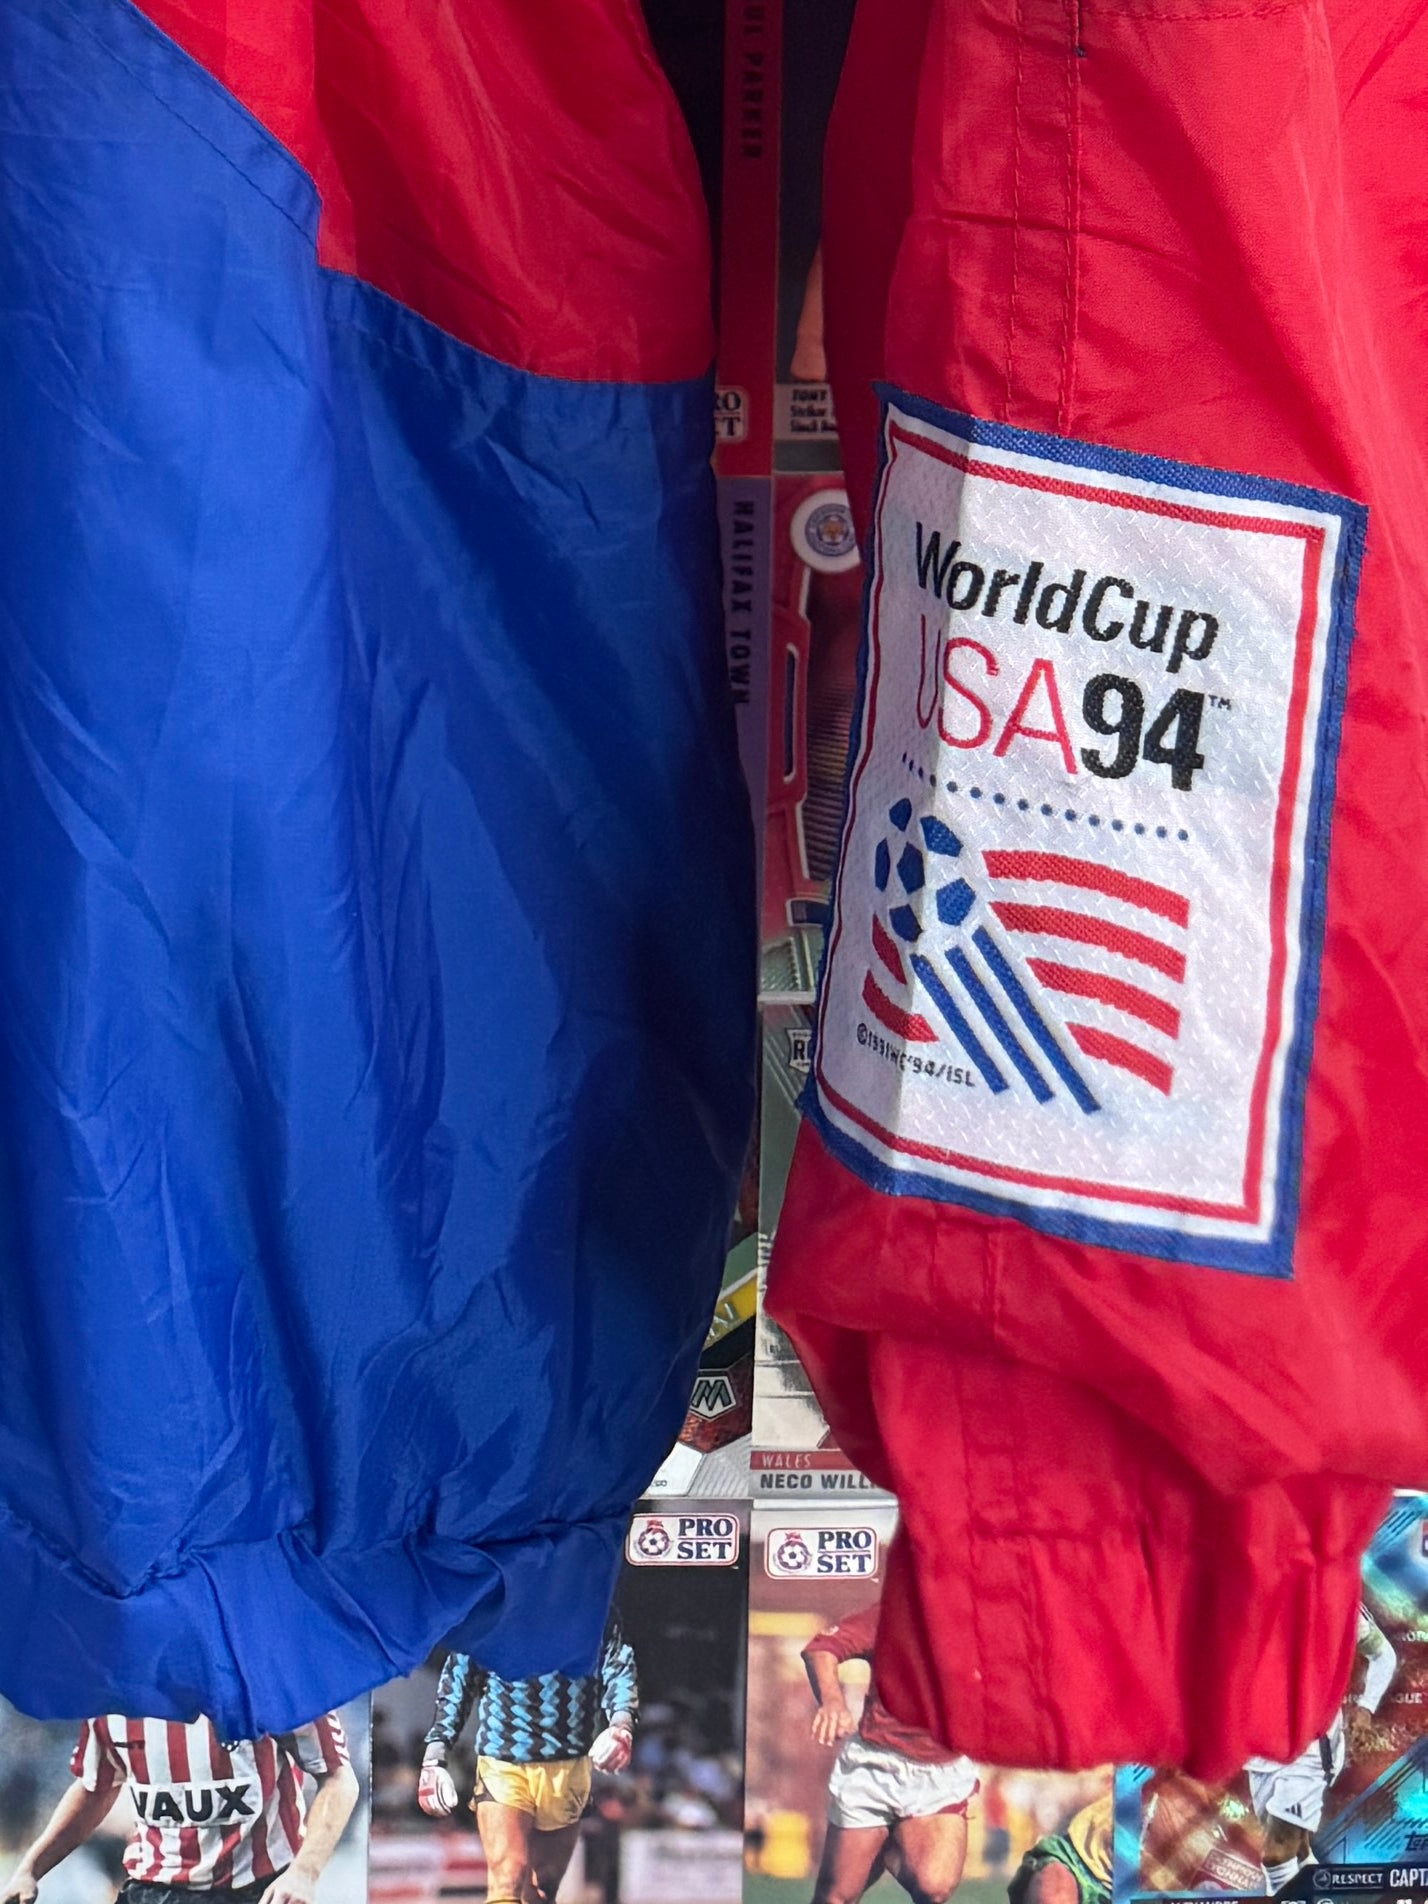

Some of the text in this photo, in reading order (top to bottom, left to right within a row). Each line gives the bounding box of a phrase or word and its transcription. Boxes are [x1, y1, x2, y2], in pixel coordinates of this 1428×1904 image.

[730, 501, 754, 612] HALIFAX
[916, 521, 1219, 674] WorldCup
[762, 1453, 811, 1468] WALES
[760, 1473, 812, 1490] NECO
[678, 1518, 733, 1537] PRO
[817, 1531, 871, 1550] PRO
[677, 1542, 732, 1560] SET
[817, 1554, 871, 1573] SET
[130, 1784, 256, 1823] VAUX
[1331, 1873, 1384, 1885] RESPECT
